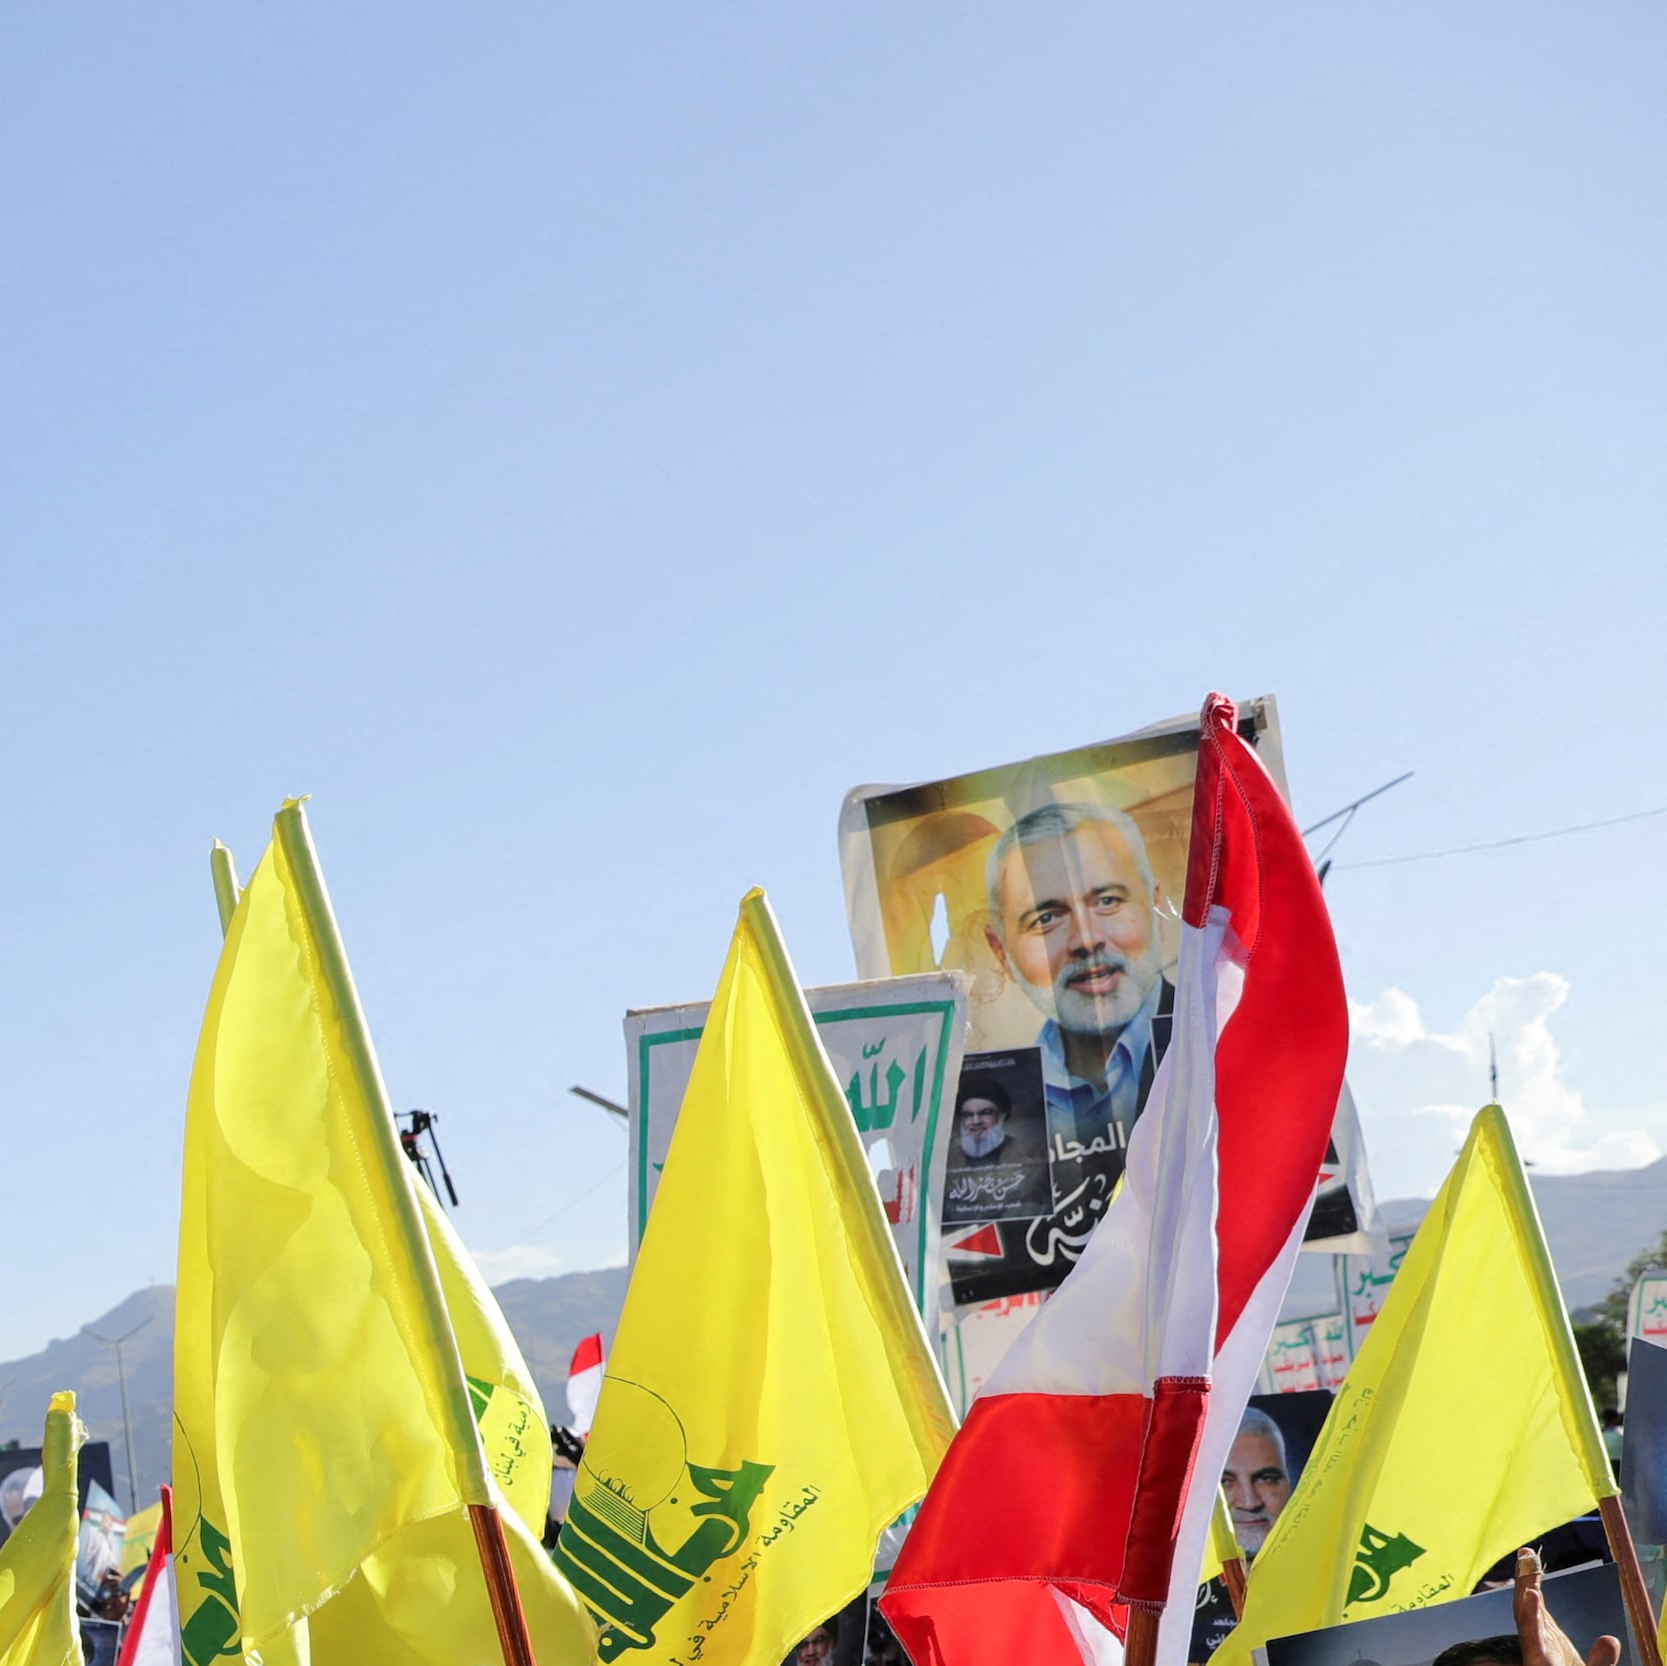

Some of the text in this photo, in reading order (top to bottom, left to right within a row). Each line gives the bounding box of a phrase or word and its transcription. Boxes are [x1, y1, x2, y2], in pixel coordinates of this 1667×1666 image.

[1049, 1120, 1126, 1165] المجا
[761, 1484, 823, 1549] المقاومة
[686, 1633, 707, 1662] في
